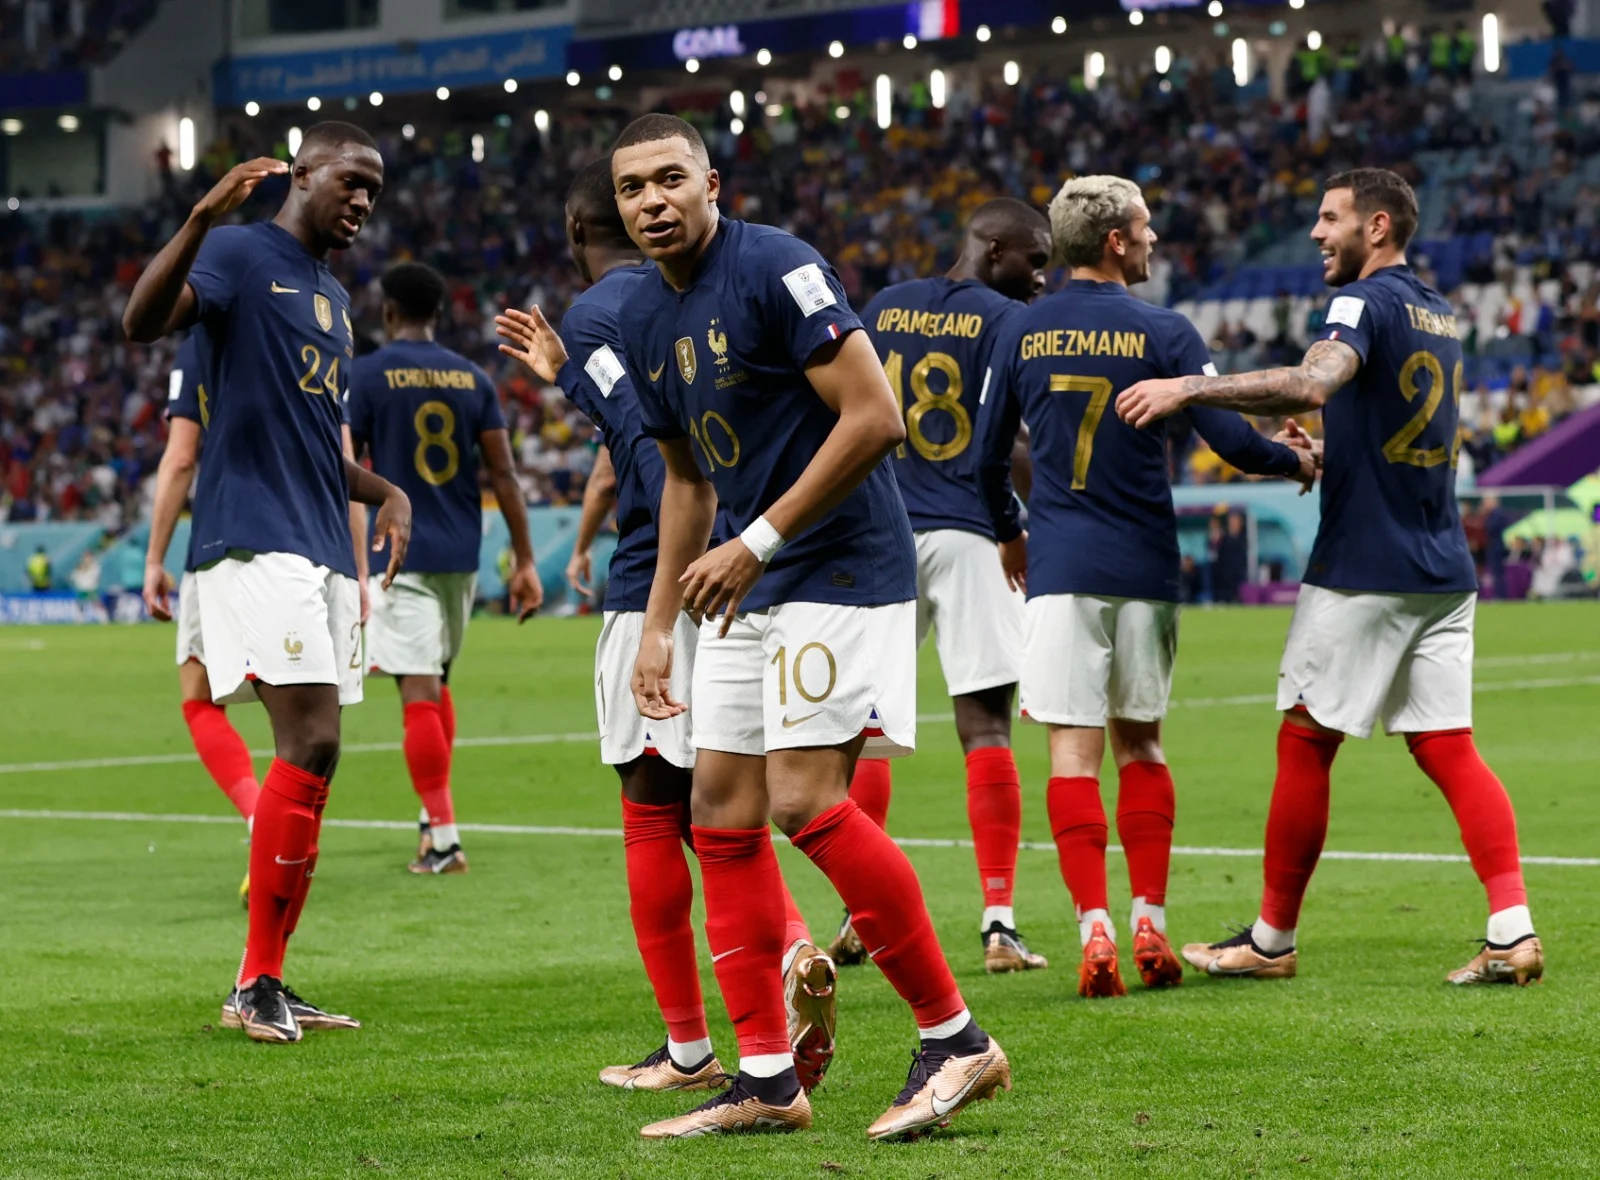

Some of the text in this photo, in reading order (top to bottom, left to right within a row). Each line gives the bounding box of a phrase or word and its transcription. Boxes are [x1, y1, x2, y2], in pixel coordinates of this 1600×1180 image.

[876, 307, 984, 339] UPAMECANO
[1021, 329, 1147, 361] GRIEZMANN
[299, 344, 340, 403] 24
[883, 348, 972, 462] 18
[413, 400, 460, 486] 8
[689, 410, 741, 473] 10
[1049, 373, 1114, 491] 7
[770, 641, 838, 706] 10
